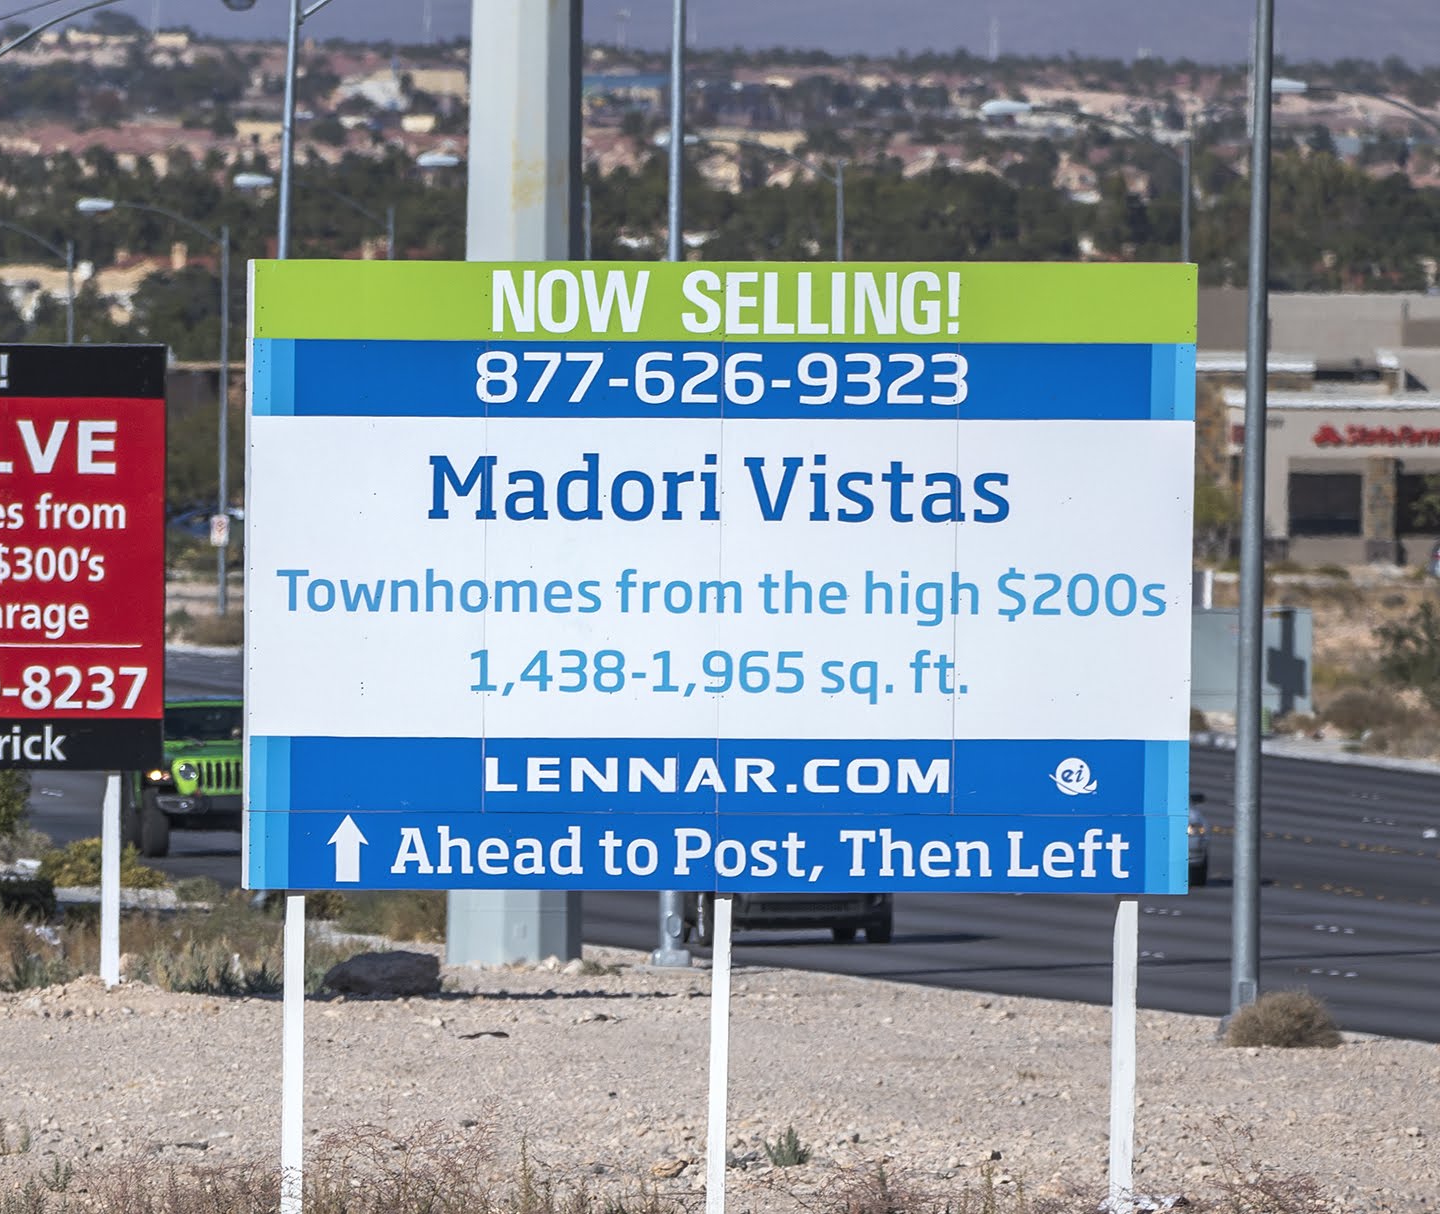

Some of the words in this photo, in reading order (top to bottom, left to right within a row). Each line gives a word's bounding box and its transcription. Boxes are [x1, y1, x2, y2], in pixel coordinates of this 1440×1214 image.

[491, 270, 649, 333] NOW
[682, 270, 960, 335] SELLING!
[477, 351, 968, 405] 877-626-9323
[35, 493, 125, 529] from
[428, 454, 720, 521] Madori
[745, 455, 1009, 523] Vistas
[277, 570, 601, 613] Townhomes
[616, 570, 741, 613] from
[759, 571, 847, 614] the
[866, 571, 978, 626] high
[998, 568, 1166, 621] $200s
[471, 650, 804, 697] 1,438-1,965
[822, 661, 893, 704] sq.
[910, 650, 967, 694] ft.
[484, 758, 950, 795] LENNAR.COM
[391, 826, 583, 875] Ahead
[599, 831, 657, 875] to
[674, 828, 823, 881] Post,
[840, 829, 992, 877] Then
[1008, 829, 1129, 878] Left
